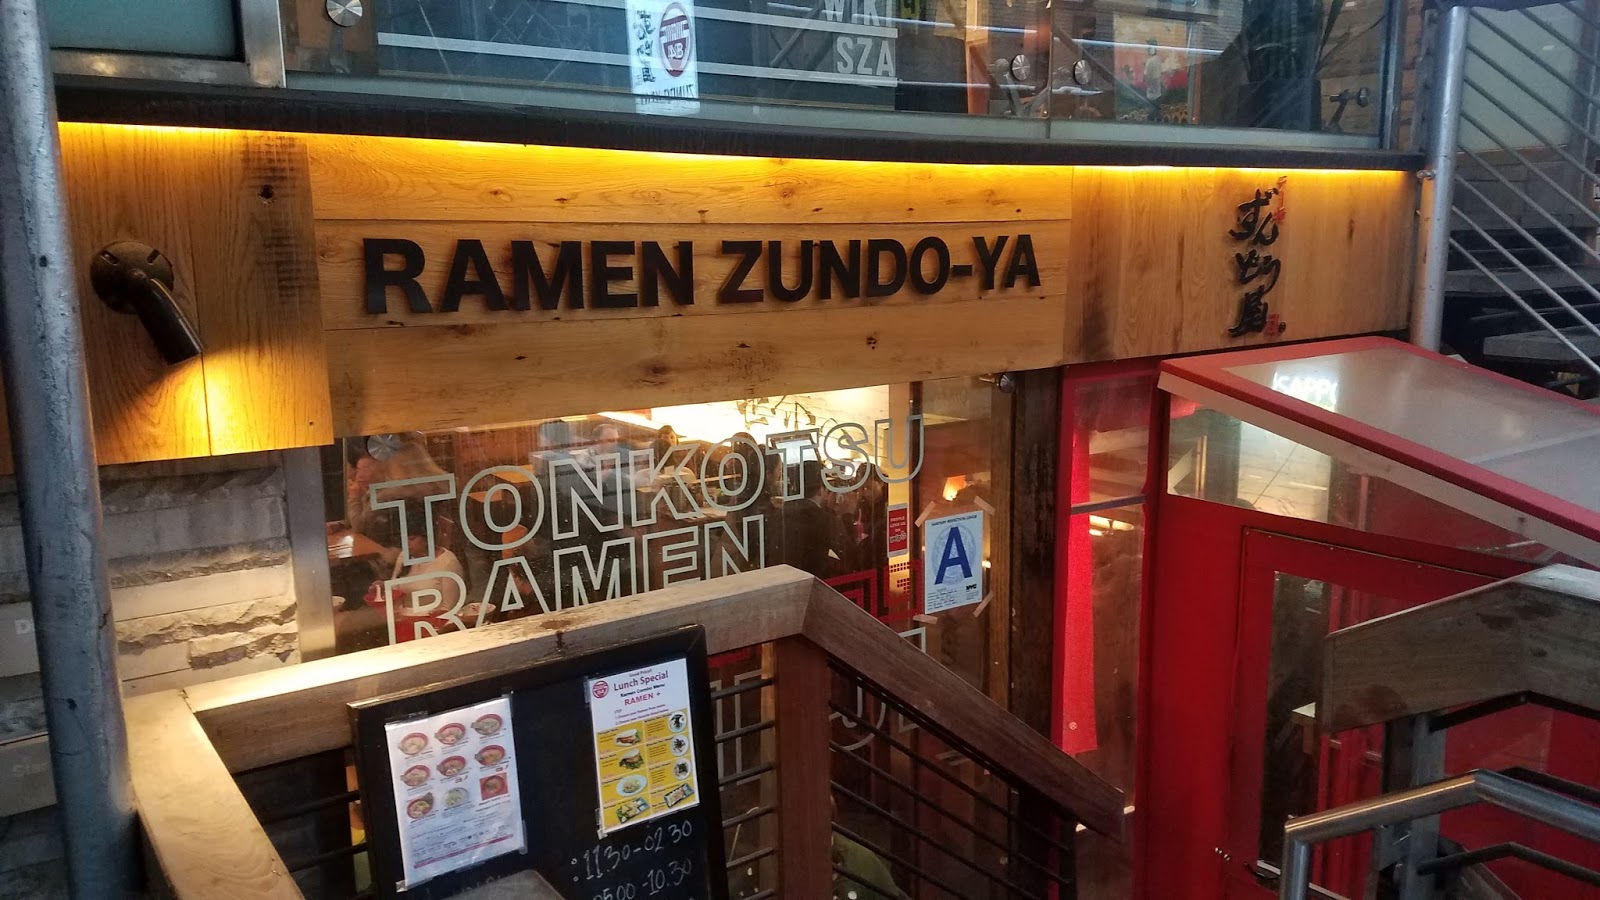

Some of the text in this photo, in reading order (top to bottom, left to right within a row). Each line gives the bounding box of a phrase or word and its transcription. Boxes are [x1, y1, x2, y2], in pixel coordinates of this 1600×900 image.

[836, 36, 895, 77] SZA
[362, 233, 1042, 314] RAMEN ZUNDO-YA
[370, 414, 925, 567] TONKOTSU
[934, 526, 973, 585] A
[613, 670, 669, 691] Lunch Special
[624, 692, 654, 706] RAMEN
